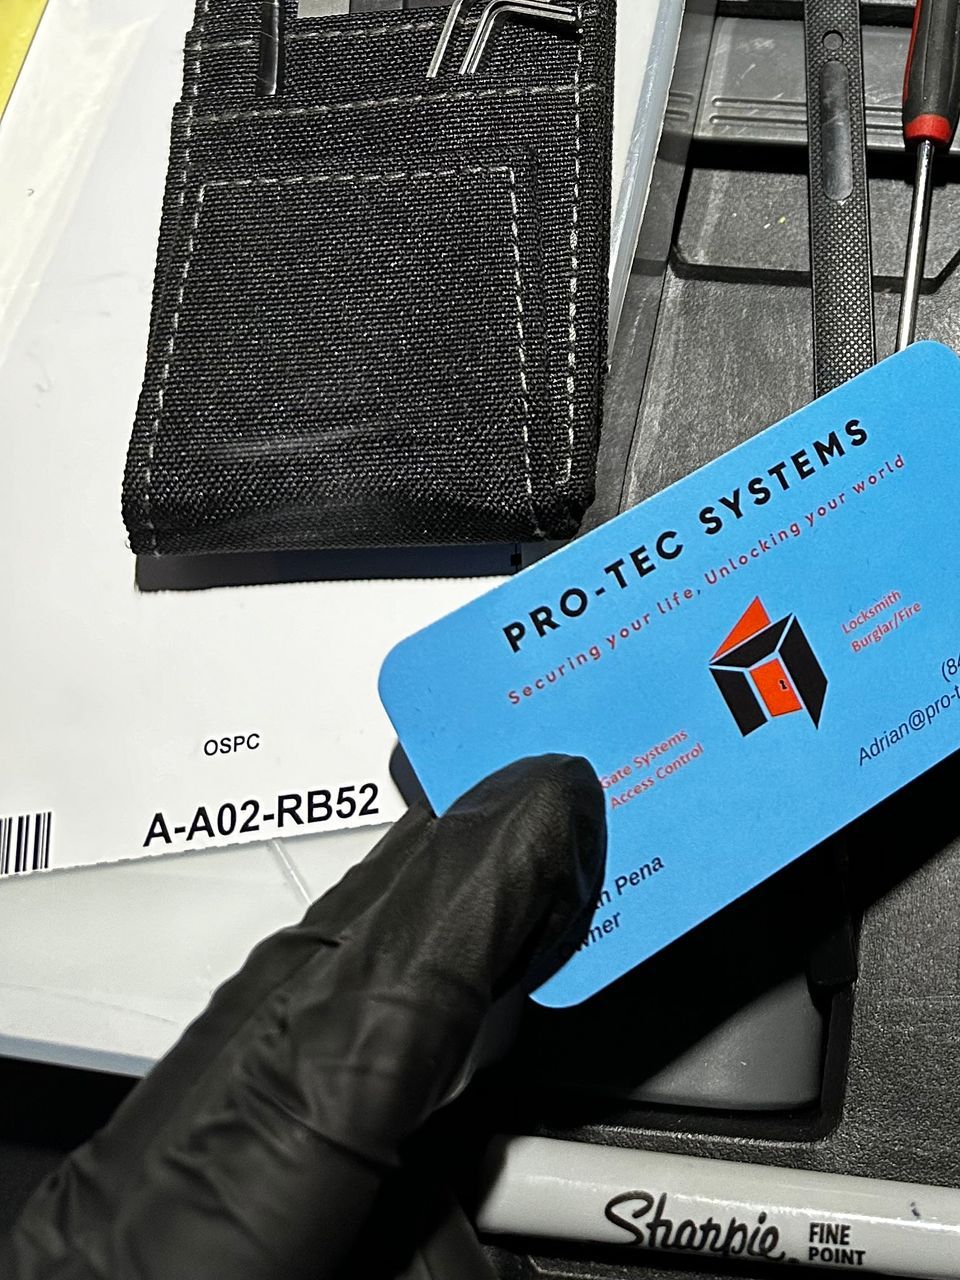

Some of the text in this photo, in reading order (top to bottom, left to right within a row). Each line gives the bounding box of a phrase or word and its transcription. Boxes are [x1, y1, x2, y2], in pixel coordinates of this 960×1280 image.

[502, 419, 869, 654] PRO-TEC SYSTEMS
[507, 454, 906, 705] Securing your life, Unlocking your world
[841, 589, 902, 634] Locksmith
[850, 601, 922, 653] Burglar/Fire
[203, 732, 261, 756] OSPC
[601, 729, 689, 790] Gate Systems
[610, 742, 705, 810] Access Control
[142, 782, 380, 848] A-A02-RB52
[614, 855, 665, 897] Pena
[604, 1188, 786, 1263] Sharpie
[808, 1221, 852, 1246] FINE
[807, 1245, 867, 1266] POINT
